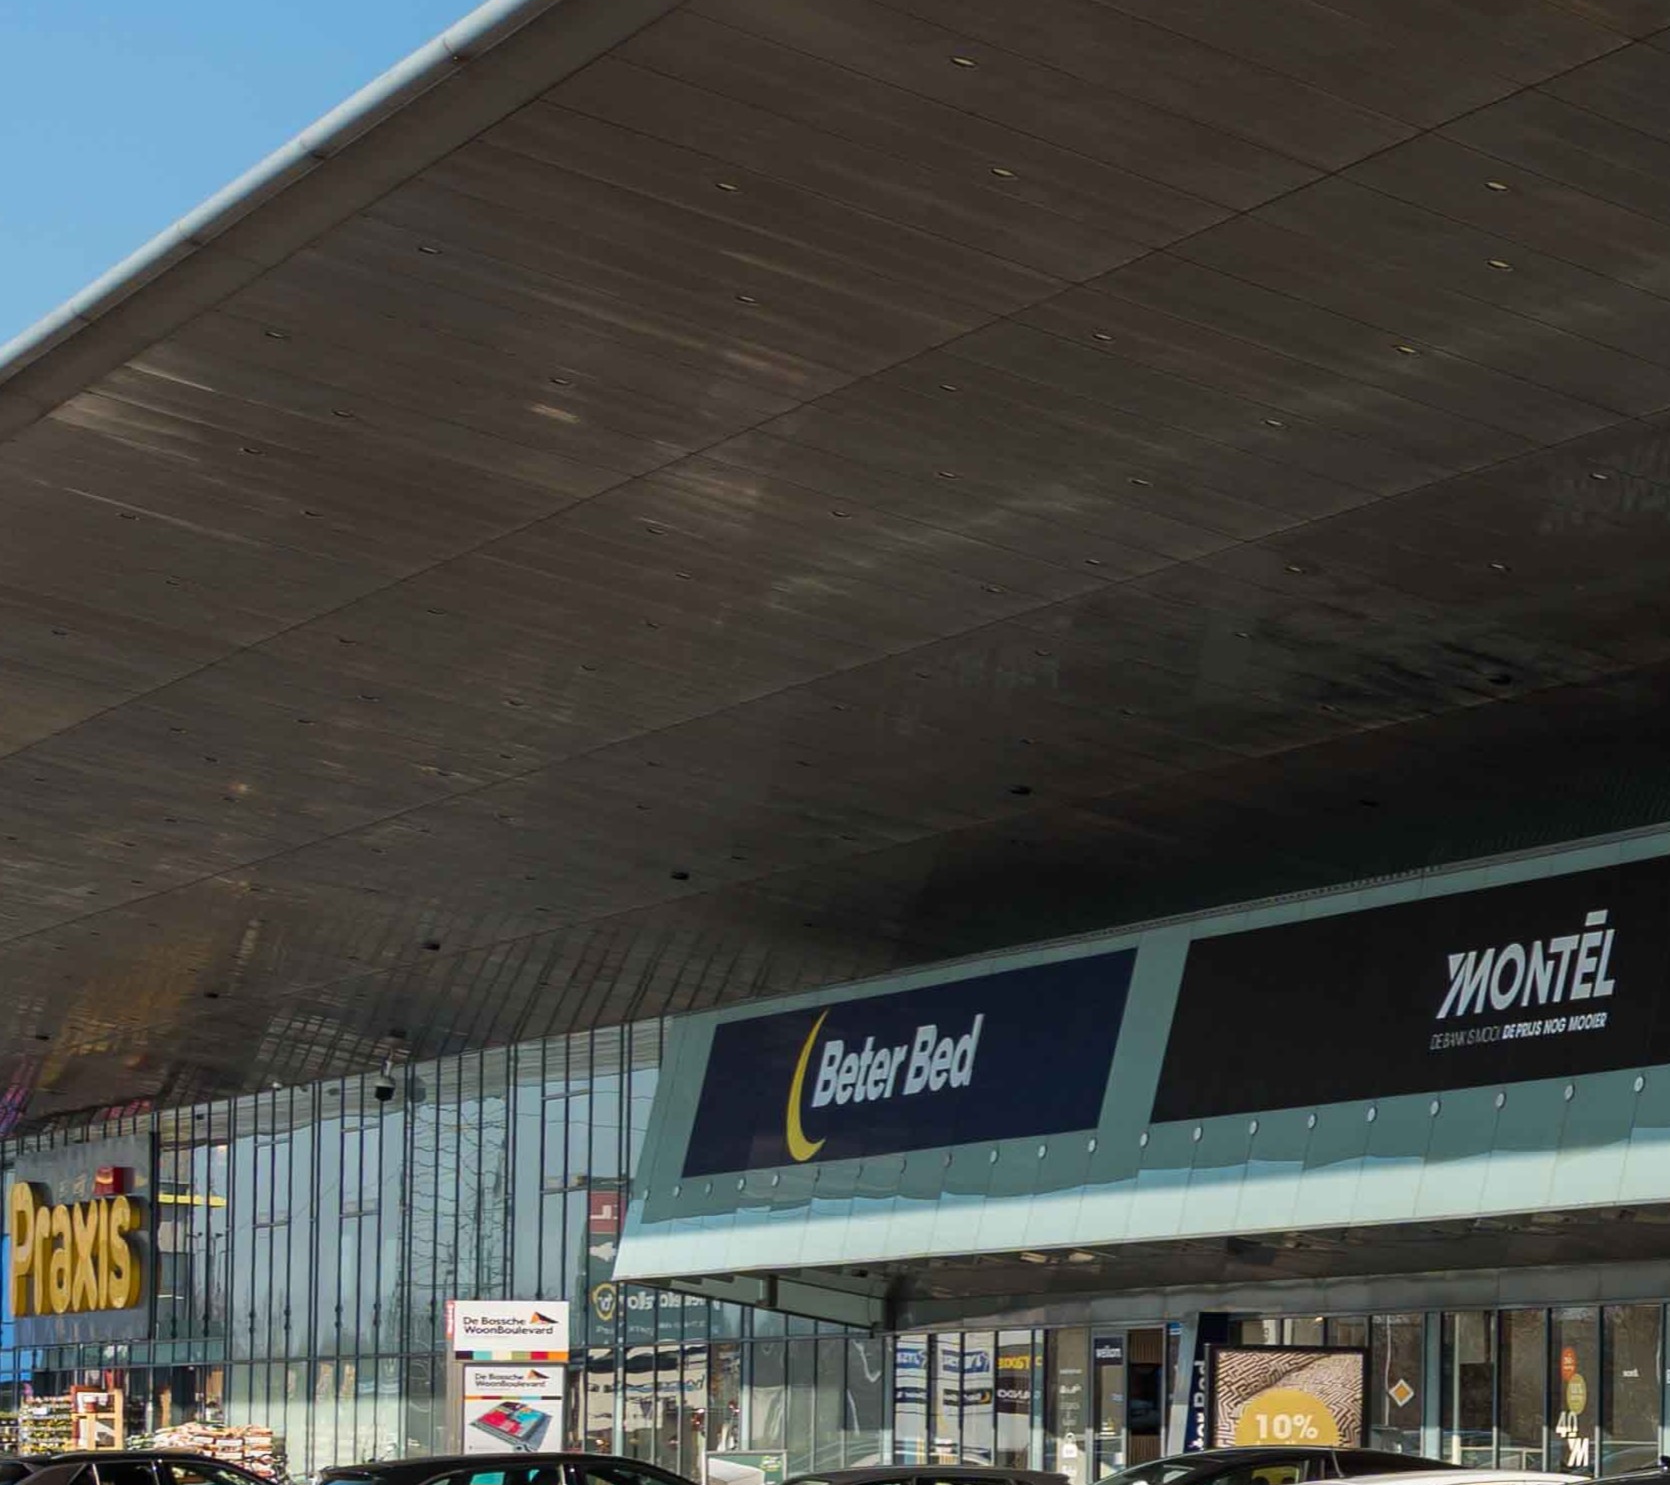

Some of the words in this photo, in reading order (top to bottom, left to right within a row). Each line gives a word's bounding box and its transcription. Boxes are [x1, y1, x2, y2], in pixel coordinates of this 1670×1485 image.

[1543, 1018, 1566, 1034] NOG
[1568, 1012, 1608, 1032] MOOIER
[811, 1036, 908, 1108] Beter
[903, 1014, 985, 1096] Bed
[10, 1181, 140, 1317] Praxis
[463, 1317, 478, 1325] De
[482, 1317, 526, 1325] Bossche
[464, 1325, 553, 1335] WoonBoulevard
[1255, 1413, 1319, 1440] 10%
